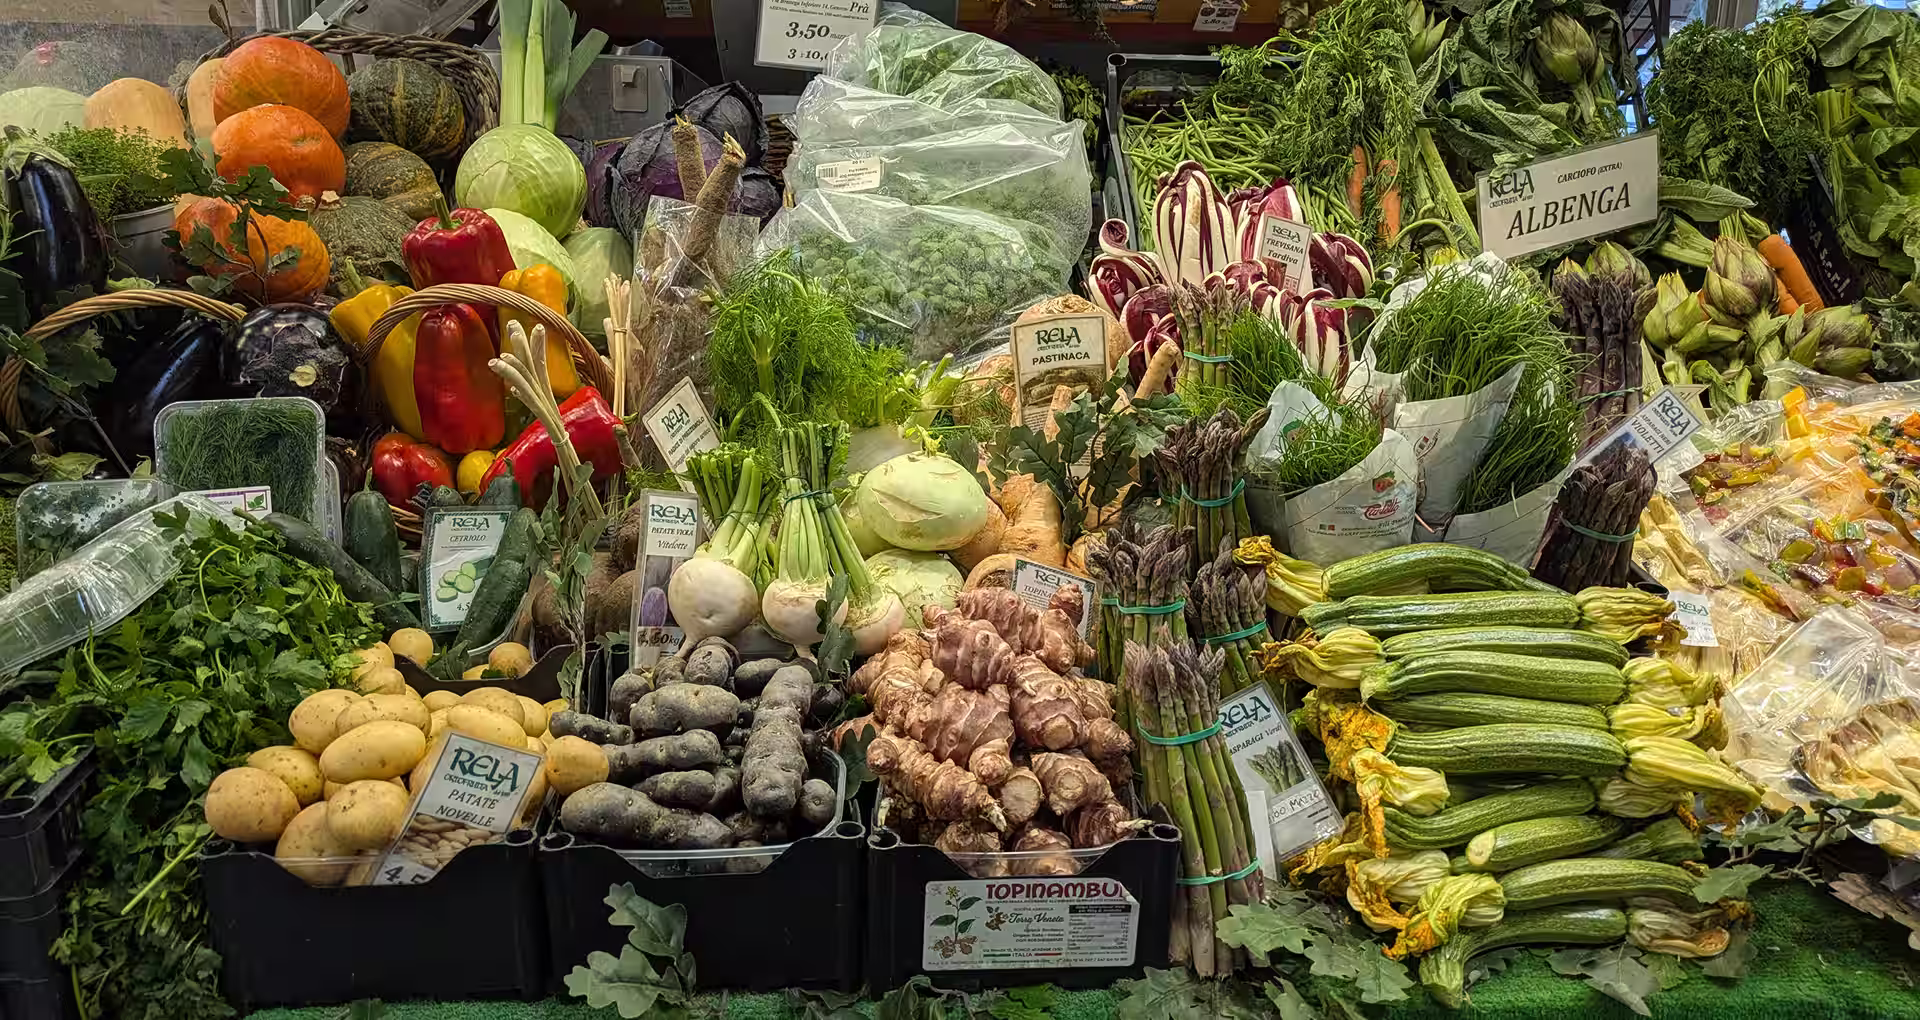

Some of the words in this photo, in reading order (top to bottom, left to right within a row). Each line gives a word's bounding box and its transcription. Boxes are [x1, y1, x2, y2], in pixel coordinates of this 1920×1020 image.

[849, 2, 869, 14] Prà
[785, 21, 830, 40] 3,50
[787, 48, 797, 59] 3
[1557, 166, 1597, 184] CARCIOFO
[1597, 161, 1622, 175] (EXTRA)
[1487, 169, 1535, 198] RELA
[1506, 182, 1631, 240] ALBENGA
[1272, 225, 1301, 242] RELA
[1266, 238, 1303, 254] TREVISANA
[1268, 249, 1298, 264] Tardiva
[1035, 327, 1081, 346] RELA
[1032, 352, 1090, 365] PASTINACA
[661, 403, 690, 433] RELA
[1641, 414, 1661, 436] ASPARAGI
[1658, 396, 1691, 436] RELA
[1631, 419, 1665, 454] VIOLETTI
[650, 504, 697, 523] RELA
[452, 517, 490, 530] RELA
[651, 527, 675, 535] PATATE
[676, 528, 694, 537] VIOLA
[450, 534, 486, 543] CETRIOLO
[657, 539, 688, 550] Vitelotte
[1677, 600, 1709, 615] RELA
[1218, 696, 1270, 728] RELA
[450, 747, 520, 792] RELA
[448, 789, 500, 810] PATATE
[435, 805, 495, 827] NOVELLE
